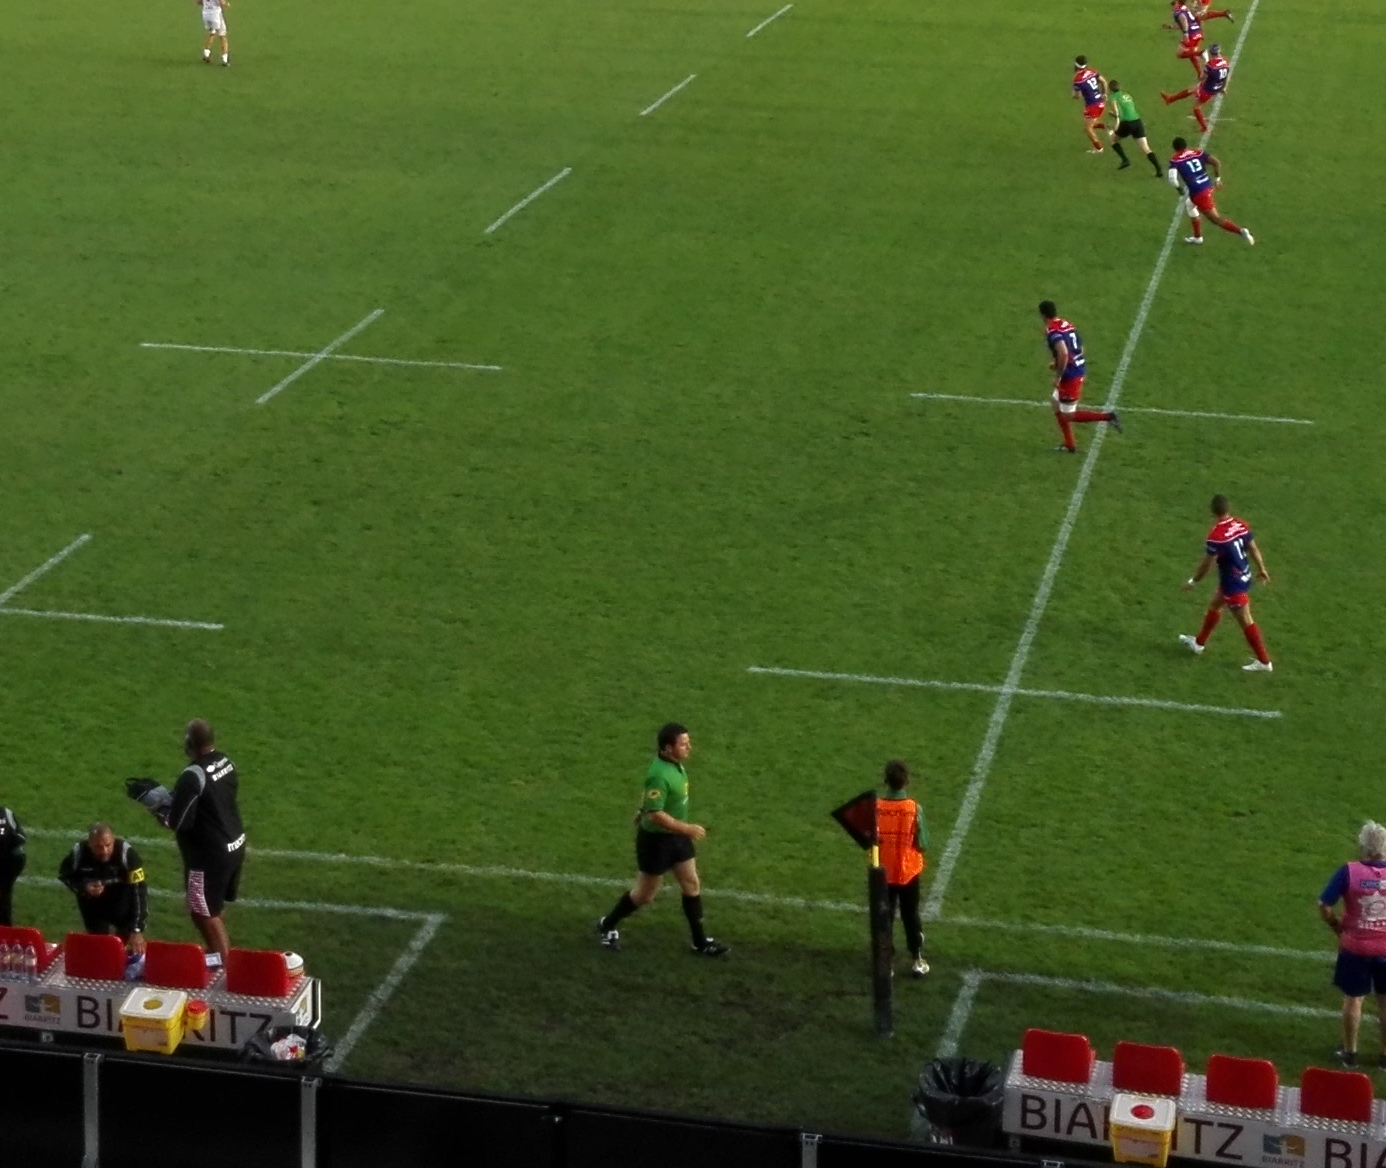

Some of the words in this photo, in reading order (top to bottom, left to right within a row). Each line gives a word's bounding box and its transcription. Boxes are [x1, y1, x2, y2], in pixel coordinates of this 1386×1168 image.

[1186, 158, 1203, 173] 13
[24, 1015, 62, 1025] BIARRITZ
[1261, 1153, 1305, 1167] BIARRITZ
